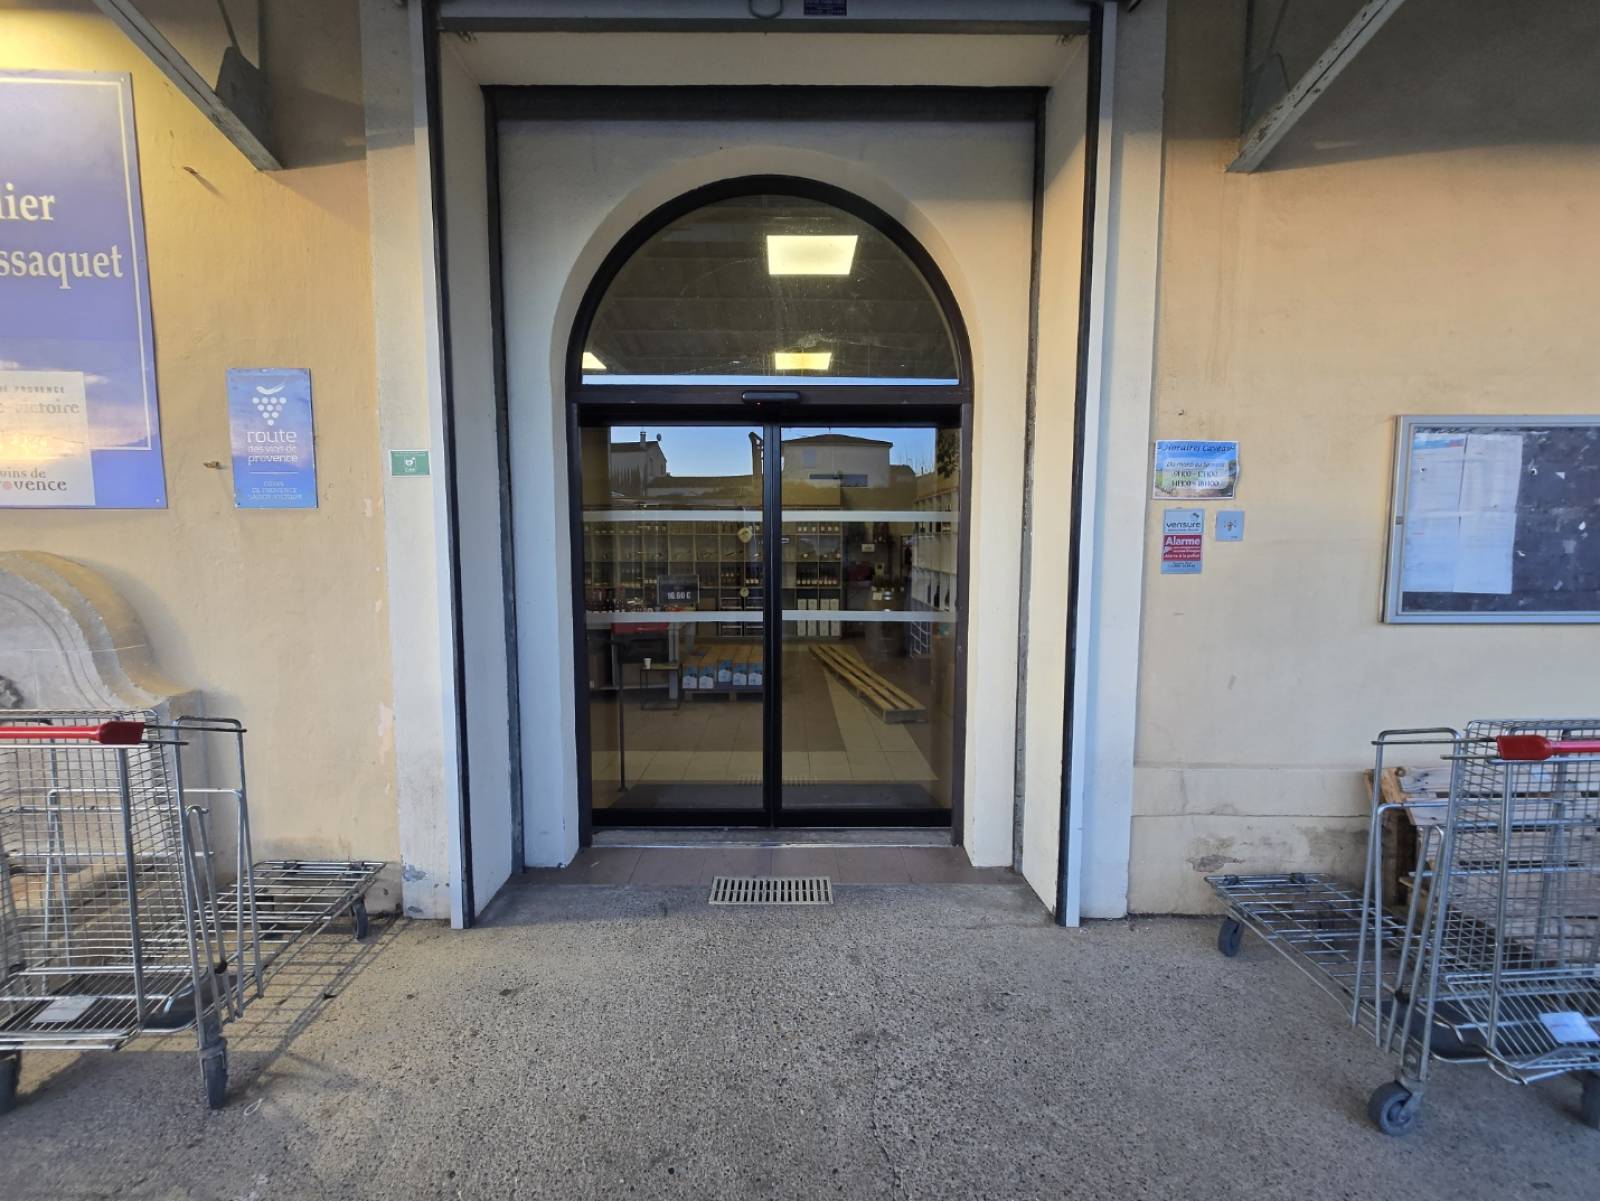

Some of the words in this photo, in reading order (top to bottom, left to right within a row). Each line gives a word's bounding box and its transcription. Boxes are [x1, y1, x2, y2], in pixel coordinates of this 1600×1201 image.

[247, 429, 297, 443] route
[30, 467, 47, 479] de
[1165, 535, 1201, 546] Alarme
